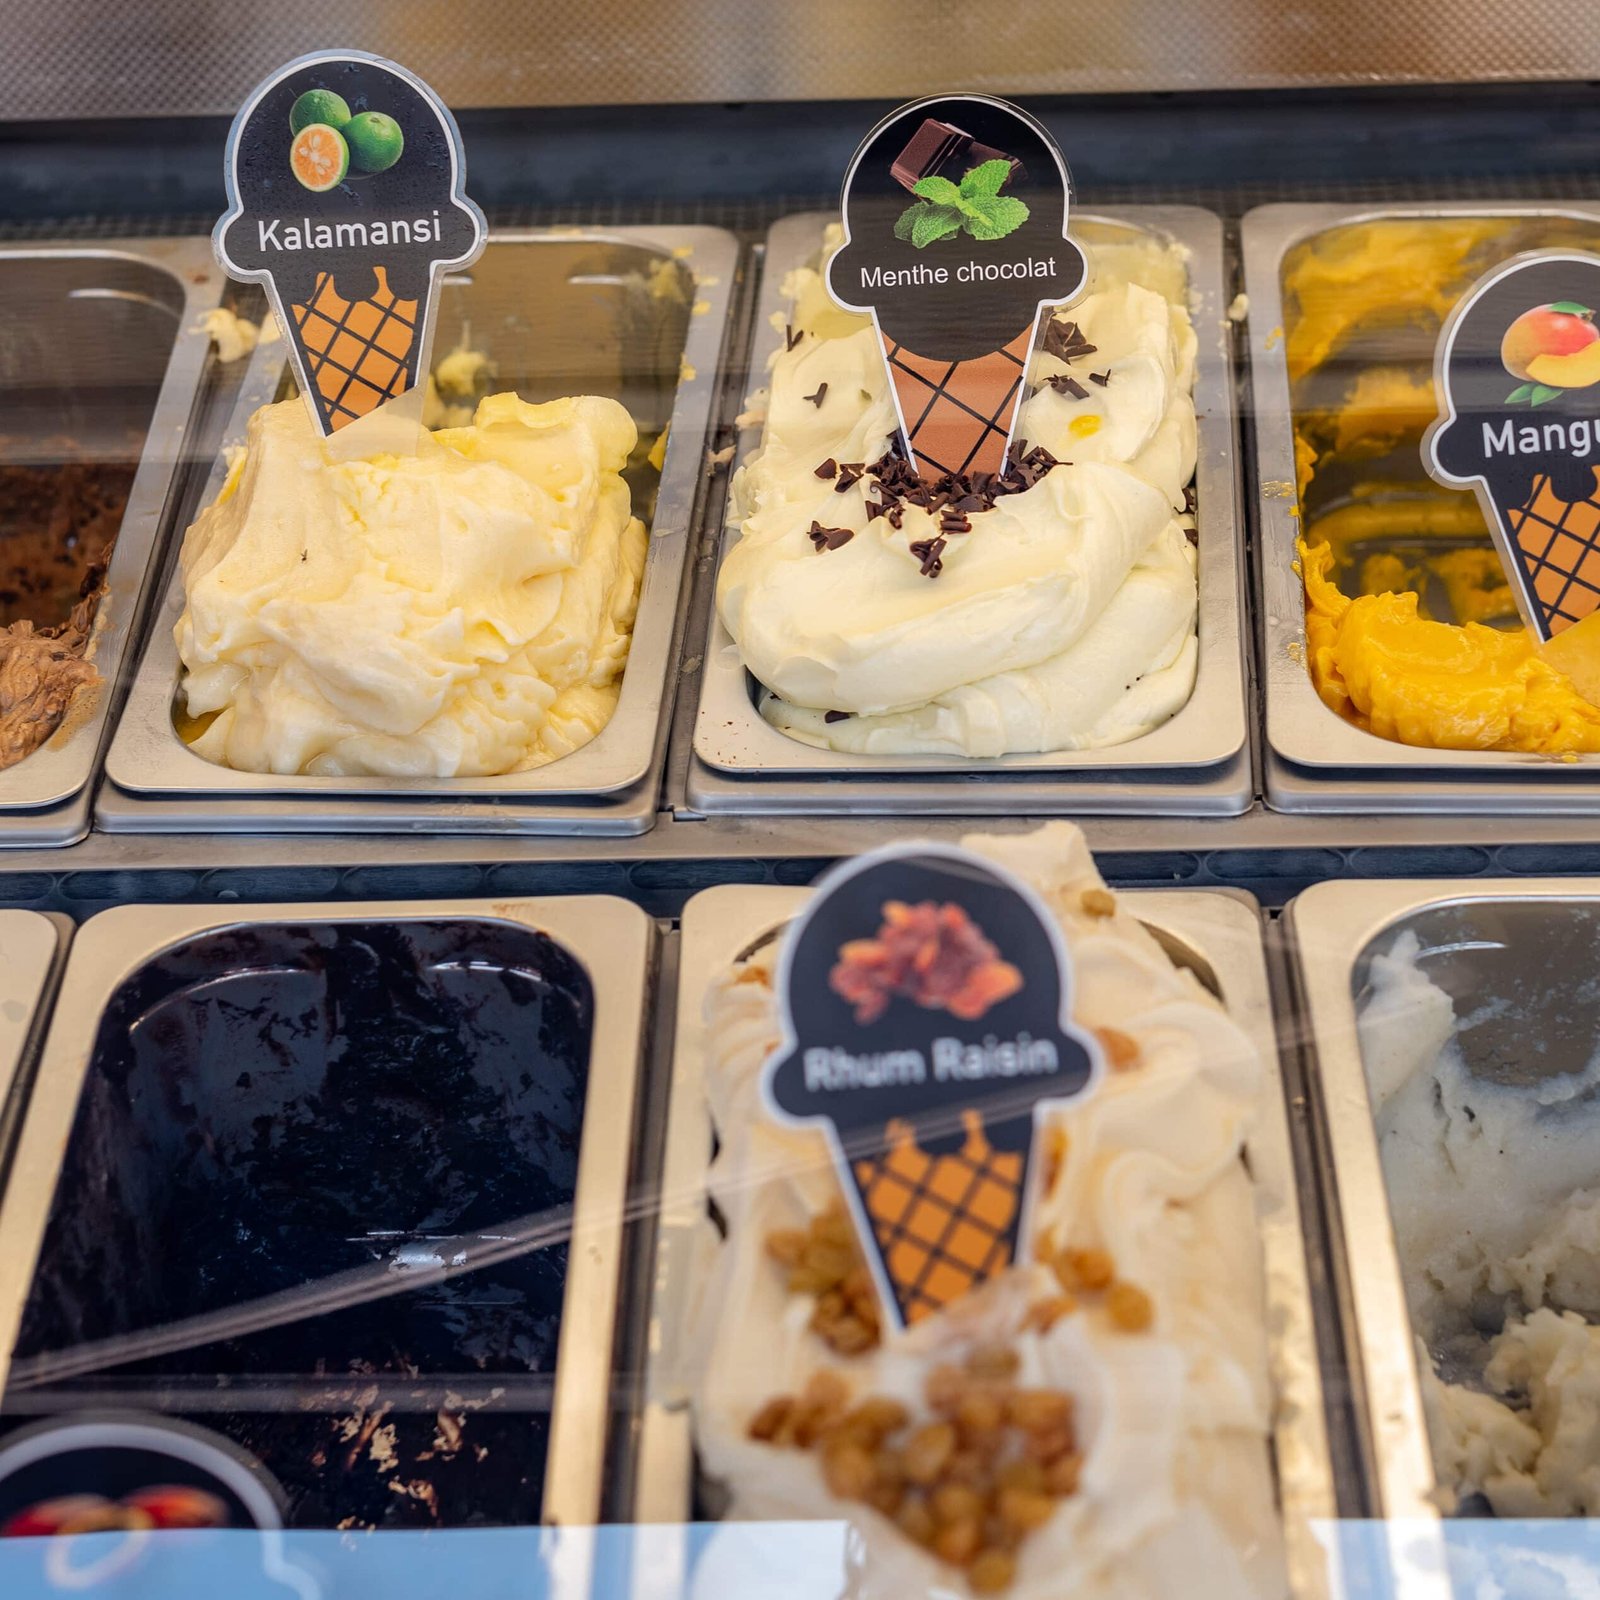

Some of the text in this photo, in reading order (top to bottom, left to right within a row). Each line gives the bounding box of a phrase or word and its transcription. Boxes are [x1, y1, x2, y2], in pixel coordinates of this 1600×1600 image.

[258, 209, 441, 252] Kalamansi
[860, 256, 1057, 288] Menthe chocolat
[1482, 419, 1600, 458] Mang
[804, 1035, 1058, 1088] Rhum Raisin
